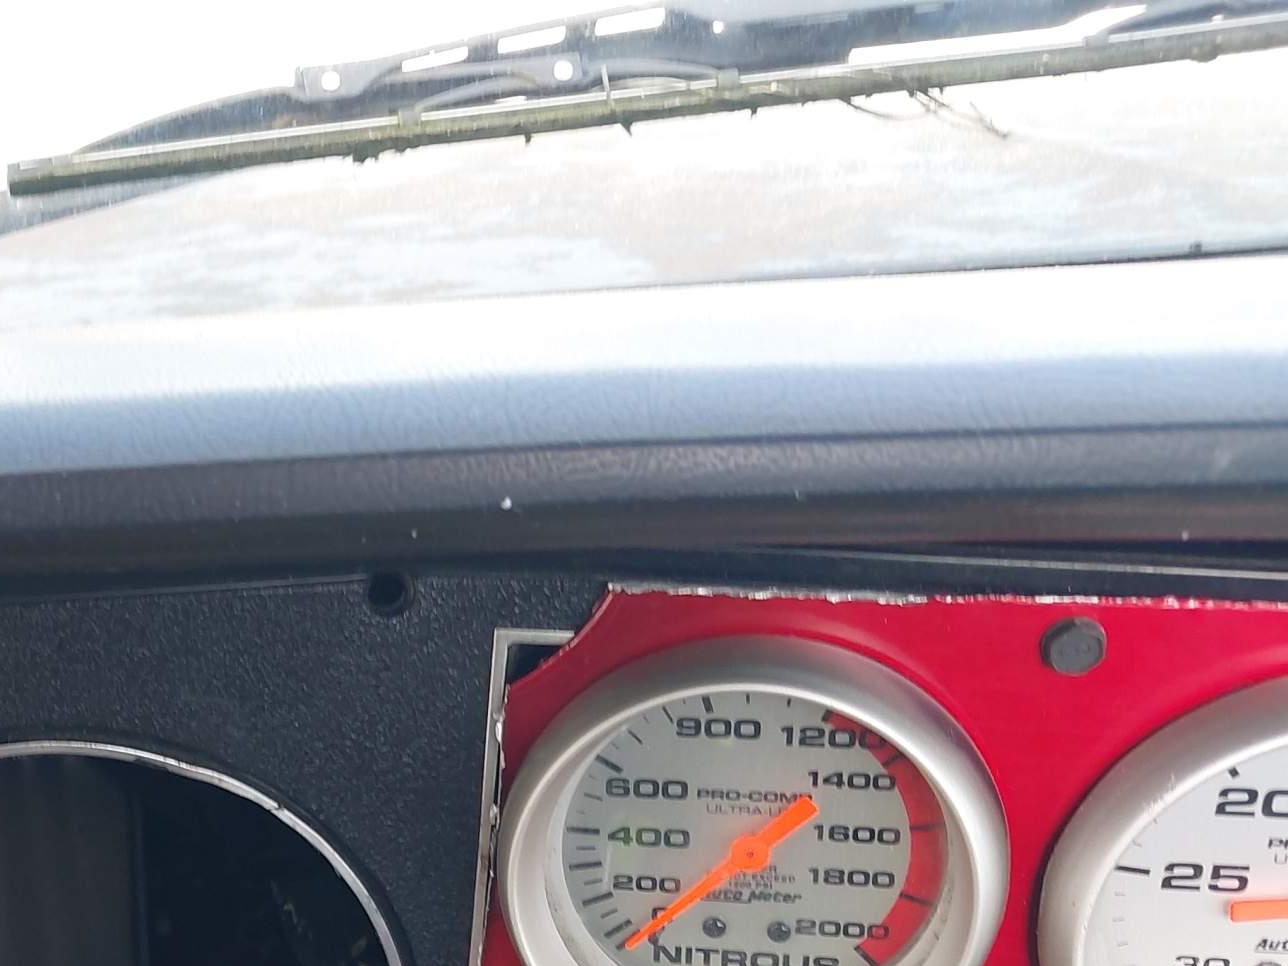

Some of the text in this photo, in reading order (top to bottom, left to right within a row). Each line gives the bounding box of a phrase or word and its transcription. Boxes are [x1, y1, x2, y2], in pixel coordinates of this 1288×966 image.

[676, 718, 761, 739] 900
[781, 725, 886, 748] 1200
[606, 778, 688, 799] 600
[807, 770, 896, 791] 1400
[608, 827, 690, 848] 400
[813, 825, 901, 845] 1600
[613, 874, 681, 894] 200
[808, 867, 896, 889] 1800
[1161, 863, 1250, 892] 25
[795, 918, 890, 939] 2000
